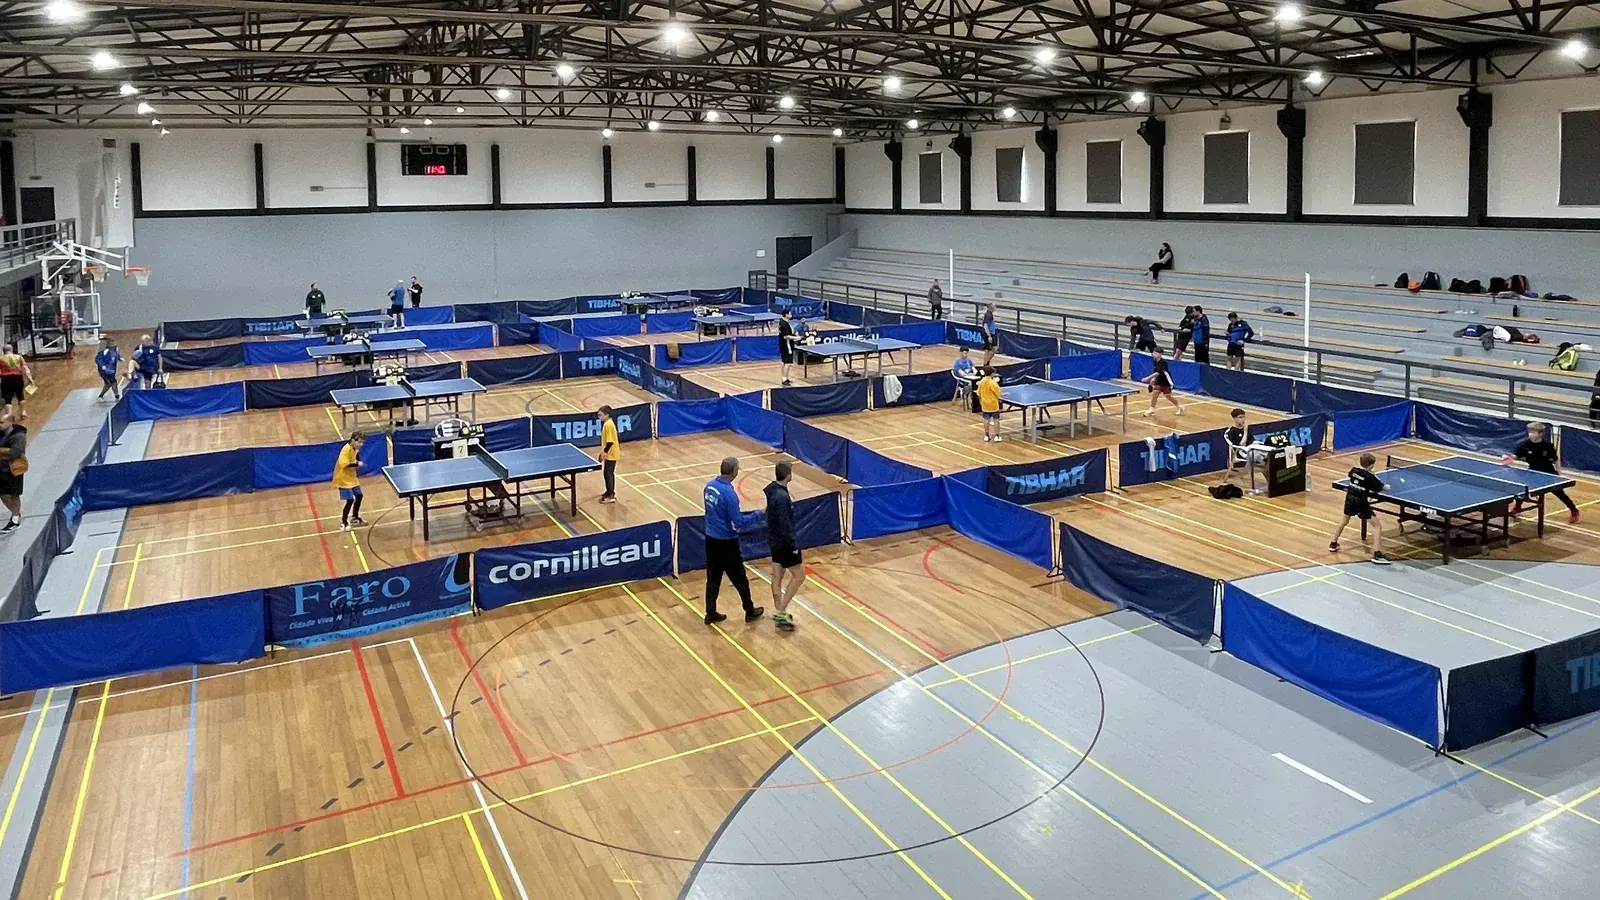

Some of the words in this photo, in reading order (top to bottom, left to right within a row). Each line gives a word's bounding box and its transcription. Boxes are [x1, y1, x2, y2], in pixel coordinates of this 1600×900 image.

[587, 299, 621, 309] TIBHA
[954, 328, 985, 344] TIBHA
[551, 414, 632, 441] TIBHR
[1005, 465, 1086, 496] TIBHAR
[488, 538, 662, 584] cornilleau
[288, 575, 411, 617] Faro
